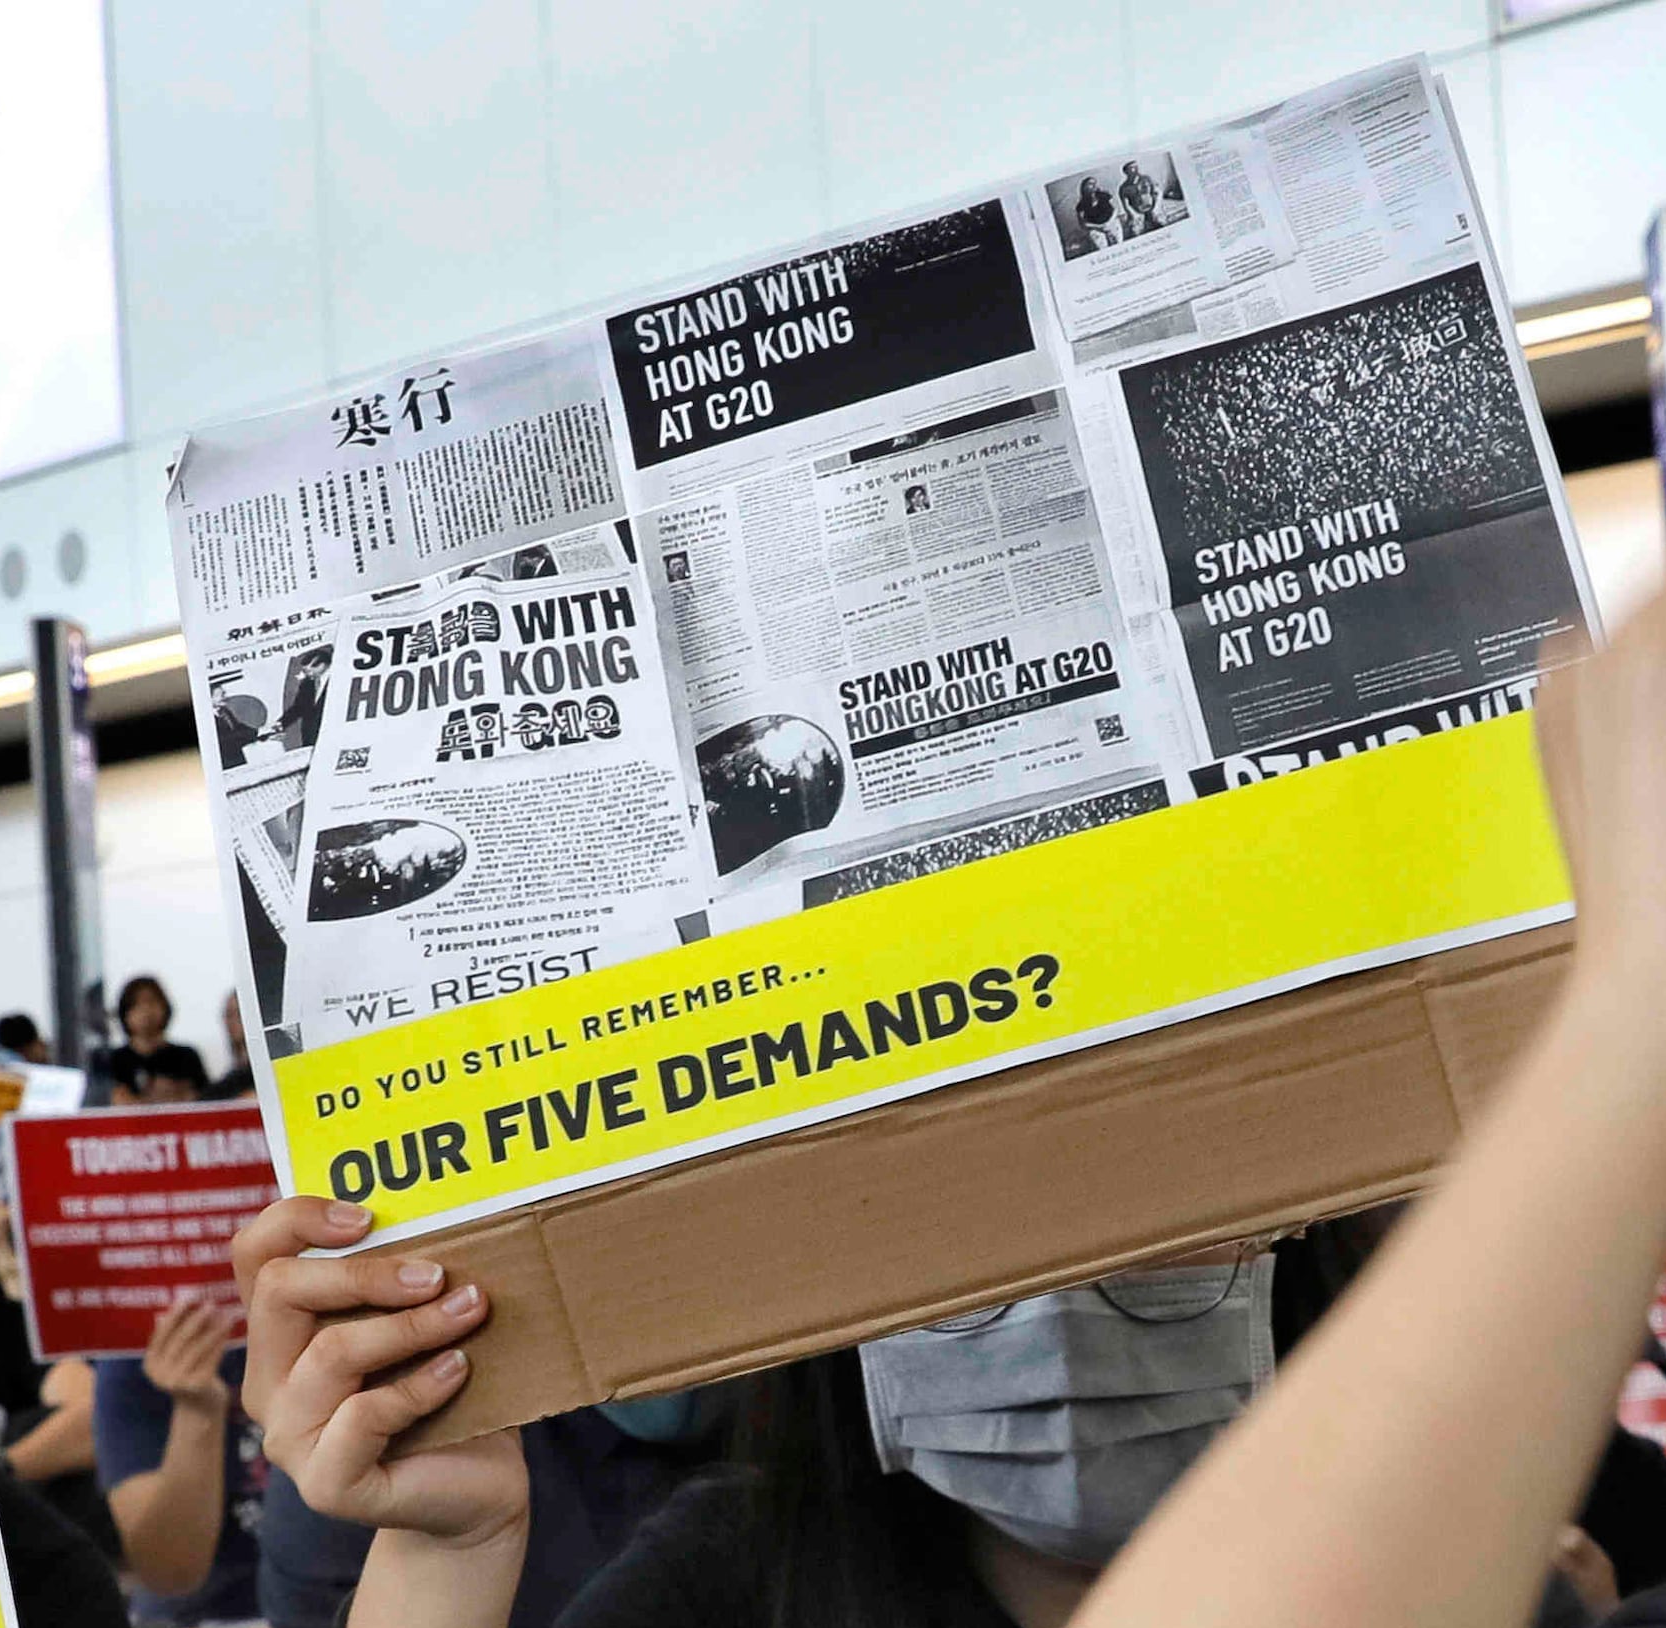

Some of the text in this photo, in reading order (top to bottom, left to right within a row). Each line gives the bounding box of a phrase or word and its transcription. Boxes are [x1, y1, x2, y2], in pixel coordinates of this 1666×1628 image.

[635, 256, 849, 354] STAND WITH
[644, 306, 854, 401] HONG KONG
[331, 368, 456, 449] 寒行
[659, 379, 774, 448] AT G20
[1194, 500, 1400, 584] STAND WITH
[1201, 541, 1407, 626] HONG KONG
[353, 586, 636, 671] STAND WITH
[1219, 606, 1332, 673] AT G20
[346, 635, 640, 722] HONG KONG
[839, 637, 1014, 710] STAND WITH
[844, 641, 1113, 741] HONGKONG AT G20
[346, 946, 600, 1027] WE RESIST
[316, 964, 826, 1118] DO YOU STILL REMEMBER...
[329, 954, 1060, 1204] OUR FIVE DEMANDS?
[67, 1132, 179, 1176] TOURIST
